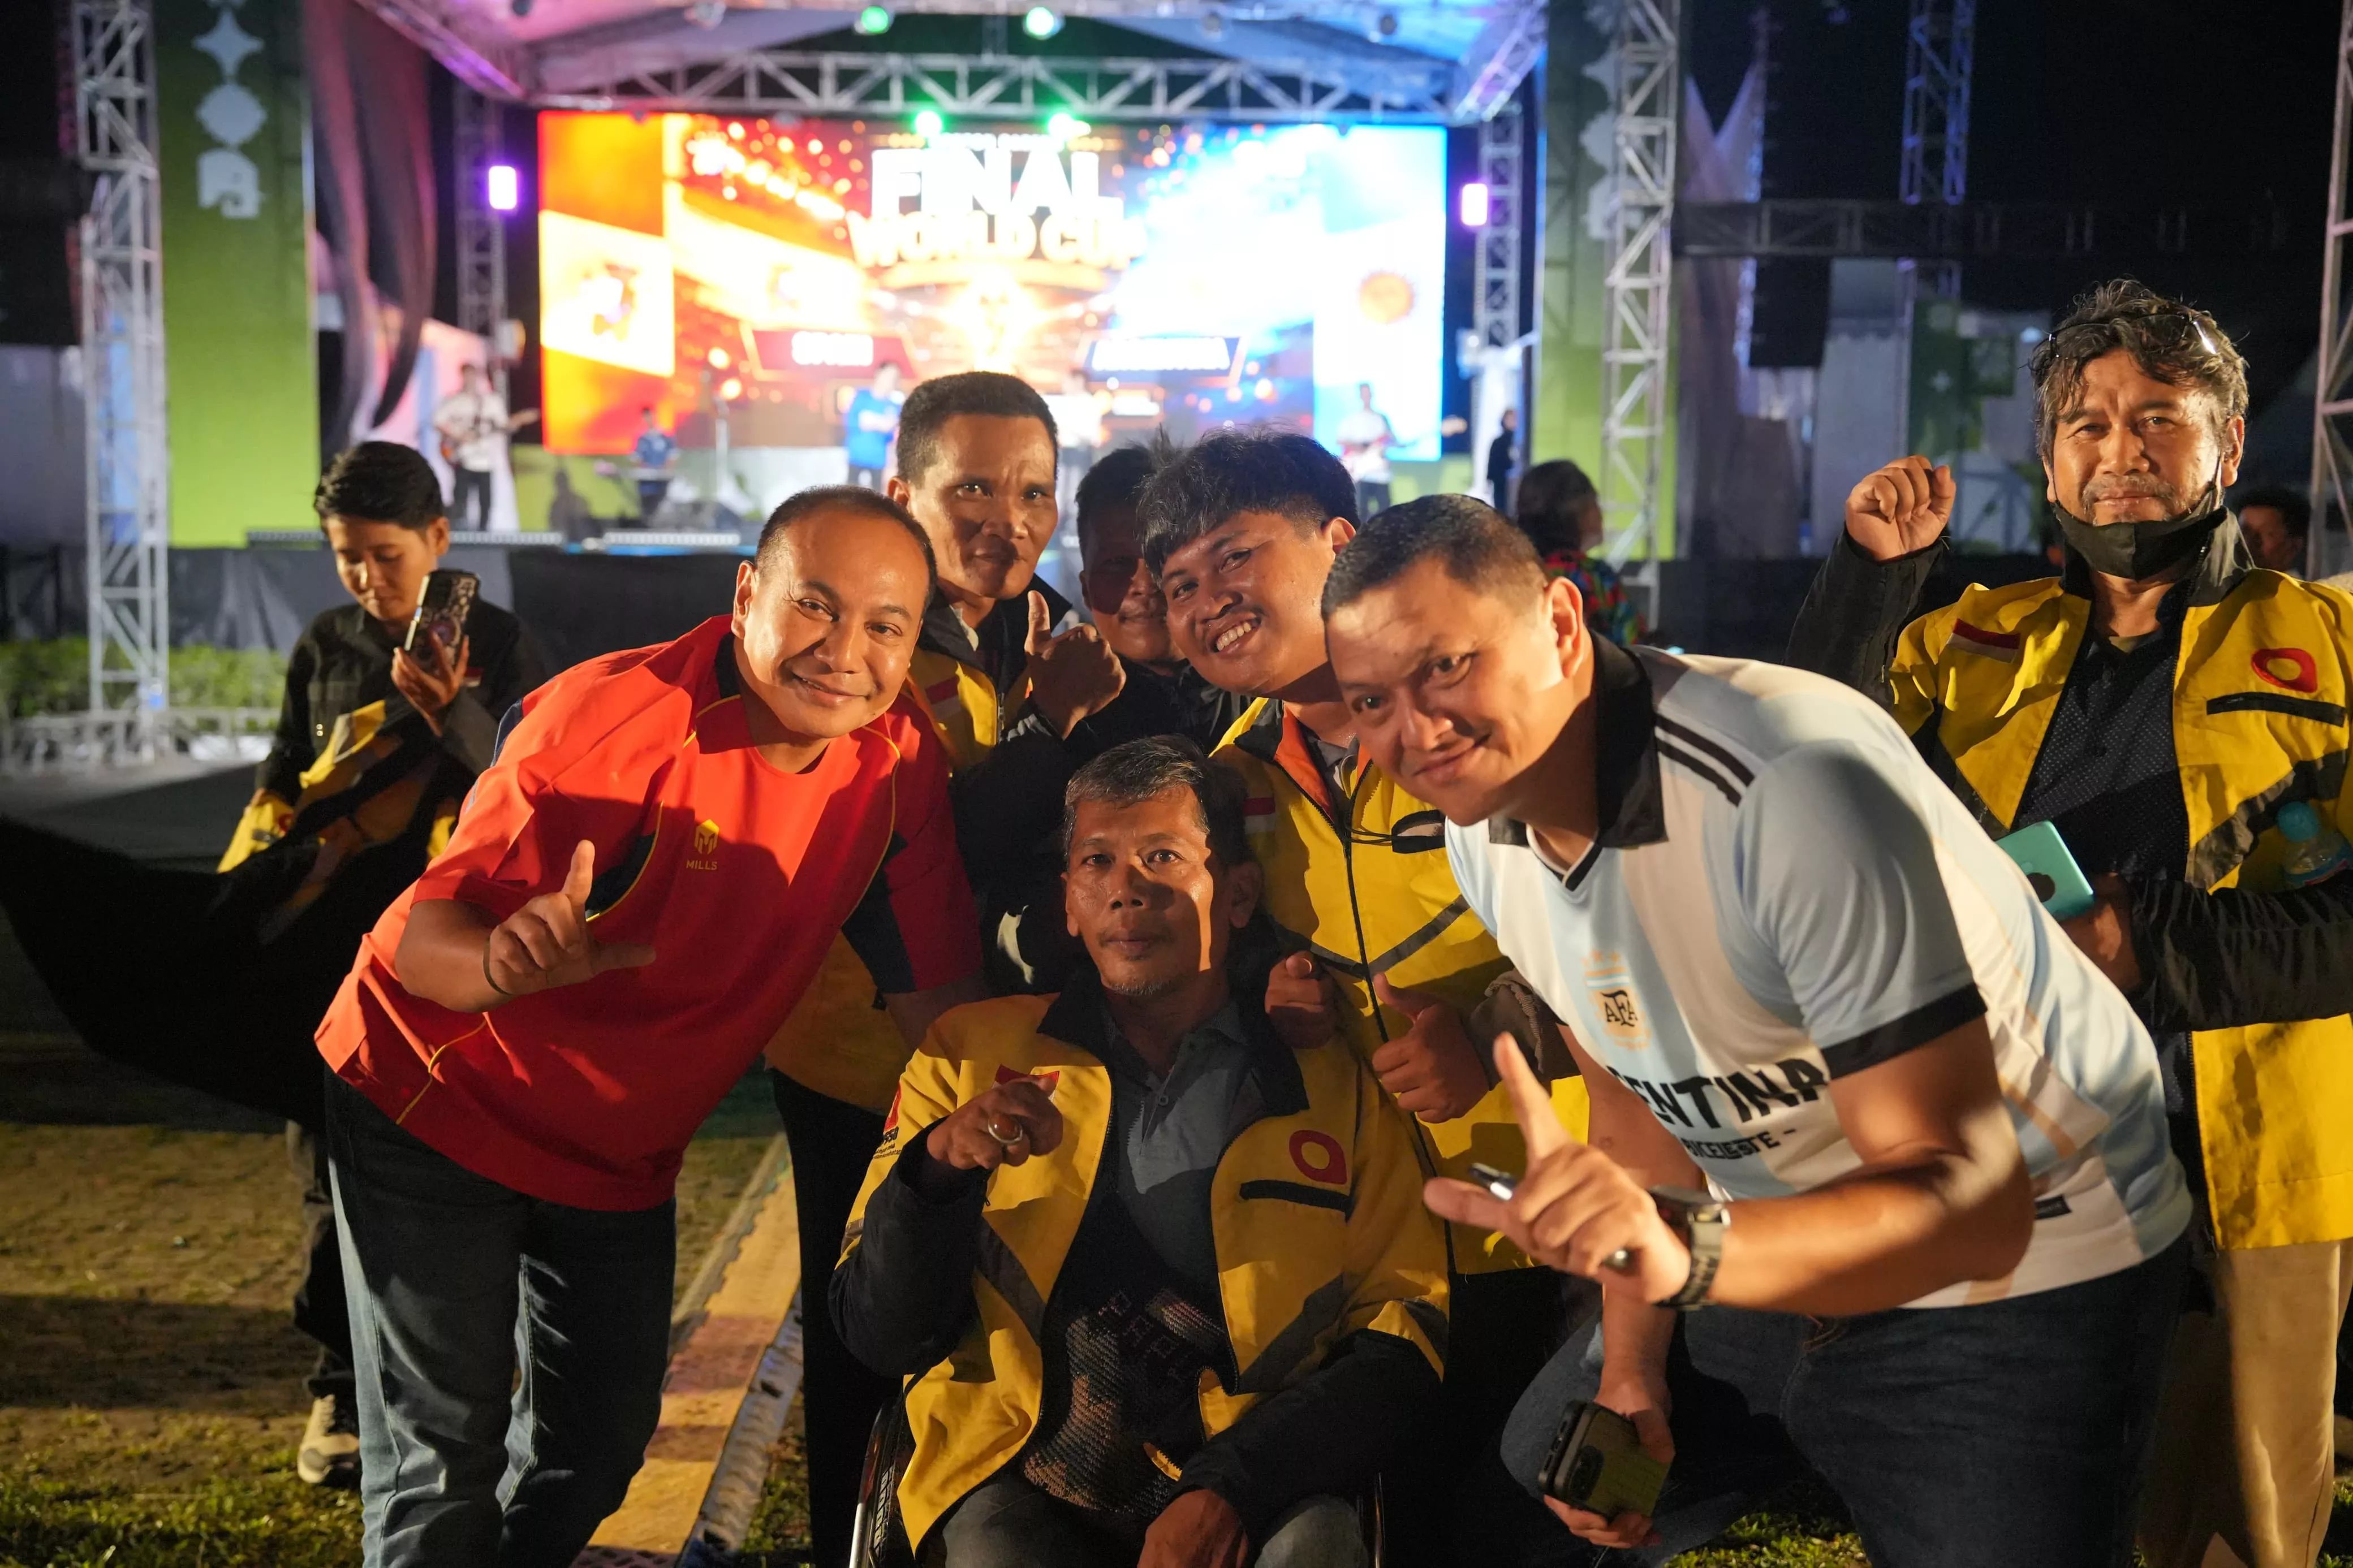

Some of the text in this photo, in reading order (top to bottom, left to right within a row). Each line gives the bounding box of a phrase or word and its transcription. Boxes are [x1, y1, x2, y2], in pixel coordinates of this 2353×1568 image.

[872, 148, 1124, 222] FINAL
[686, 859, 718, 871] MILLS
[1600, 990, 1638, 1027] AFA
[1606, 1059, 1828, 1129] ENTINA
